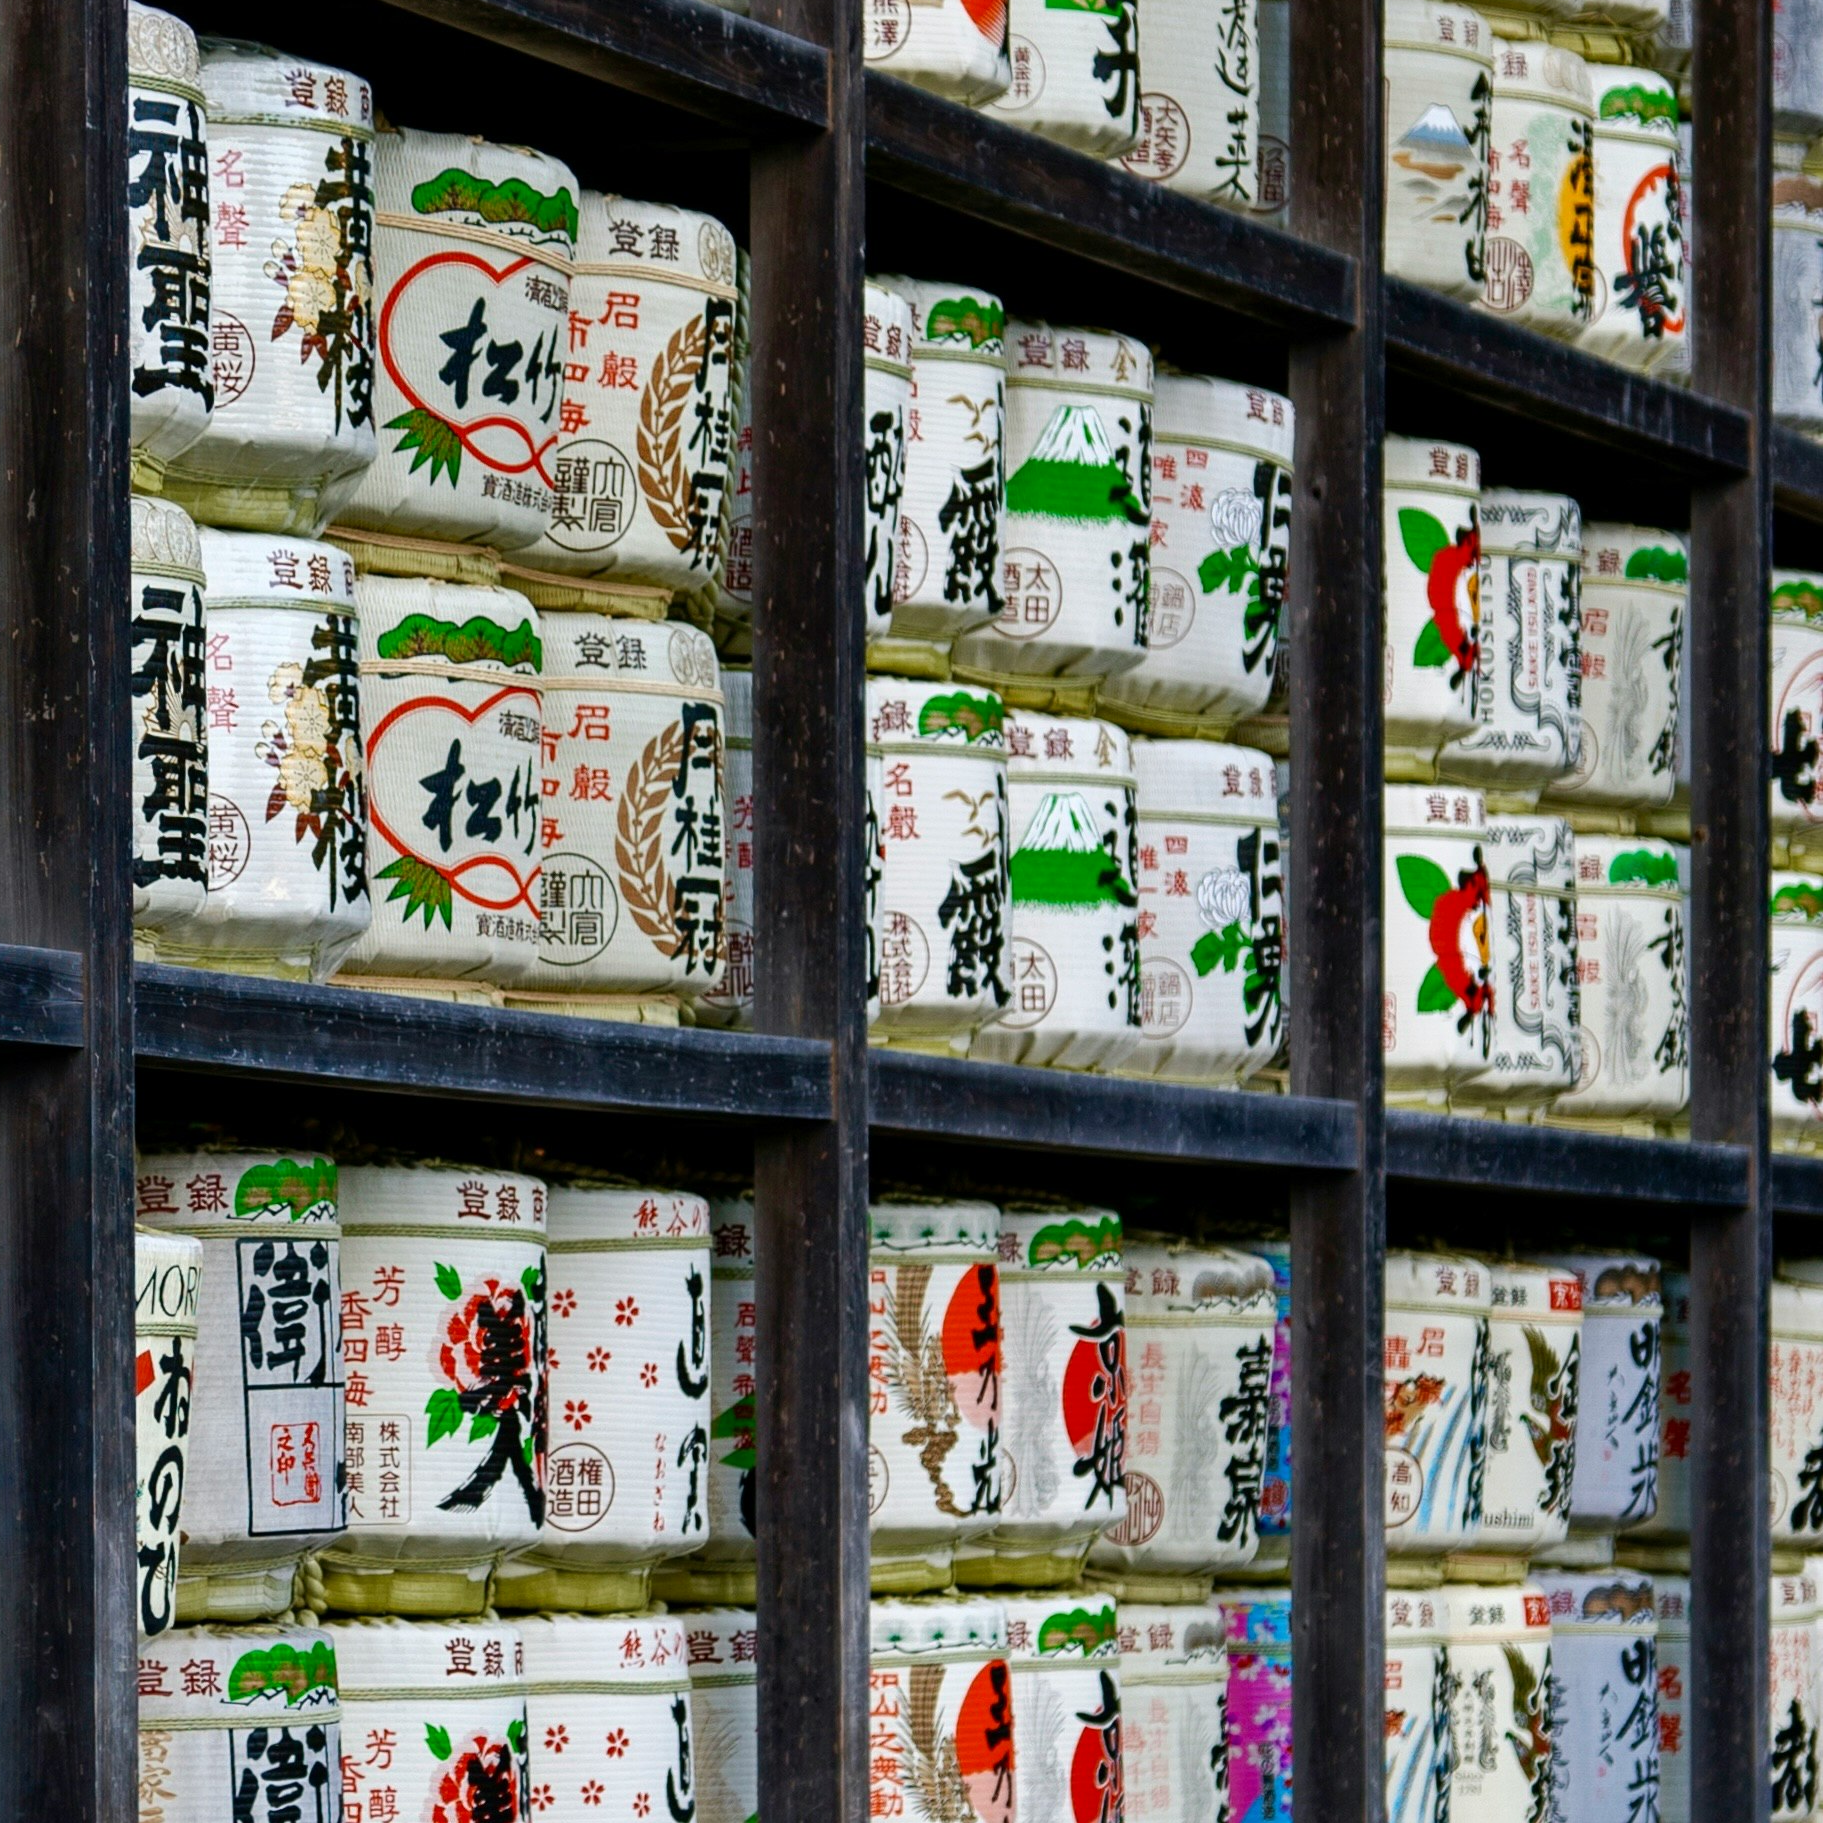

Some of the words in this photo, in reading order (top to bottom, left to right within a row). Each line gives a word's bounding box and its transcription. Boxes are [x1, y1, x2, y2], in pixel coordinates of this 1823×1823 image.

[682, 297, 736, 572] 月桂冠
[670, 701, 725, 977] 月桂冠
[372, 1266, 407, 1361] 芳醇
[377, 1420, 403, 1520] 株式会社
